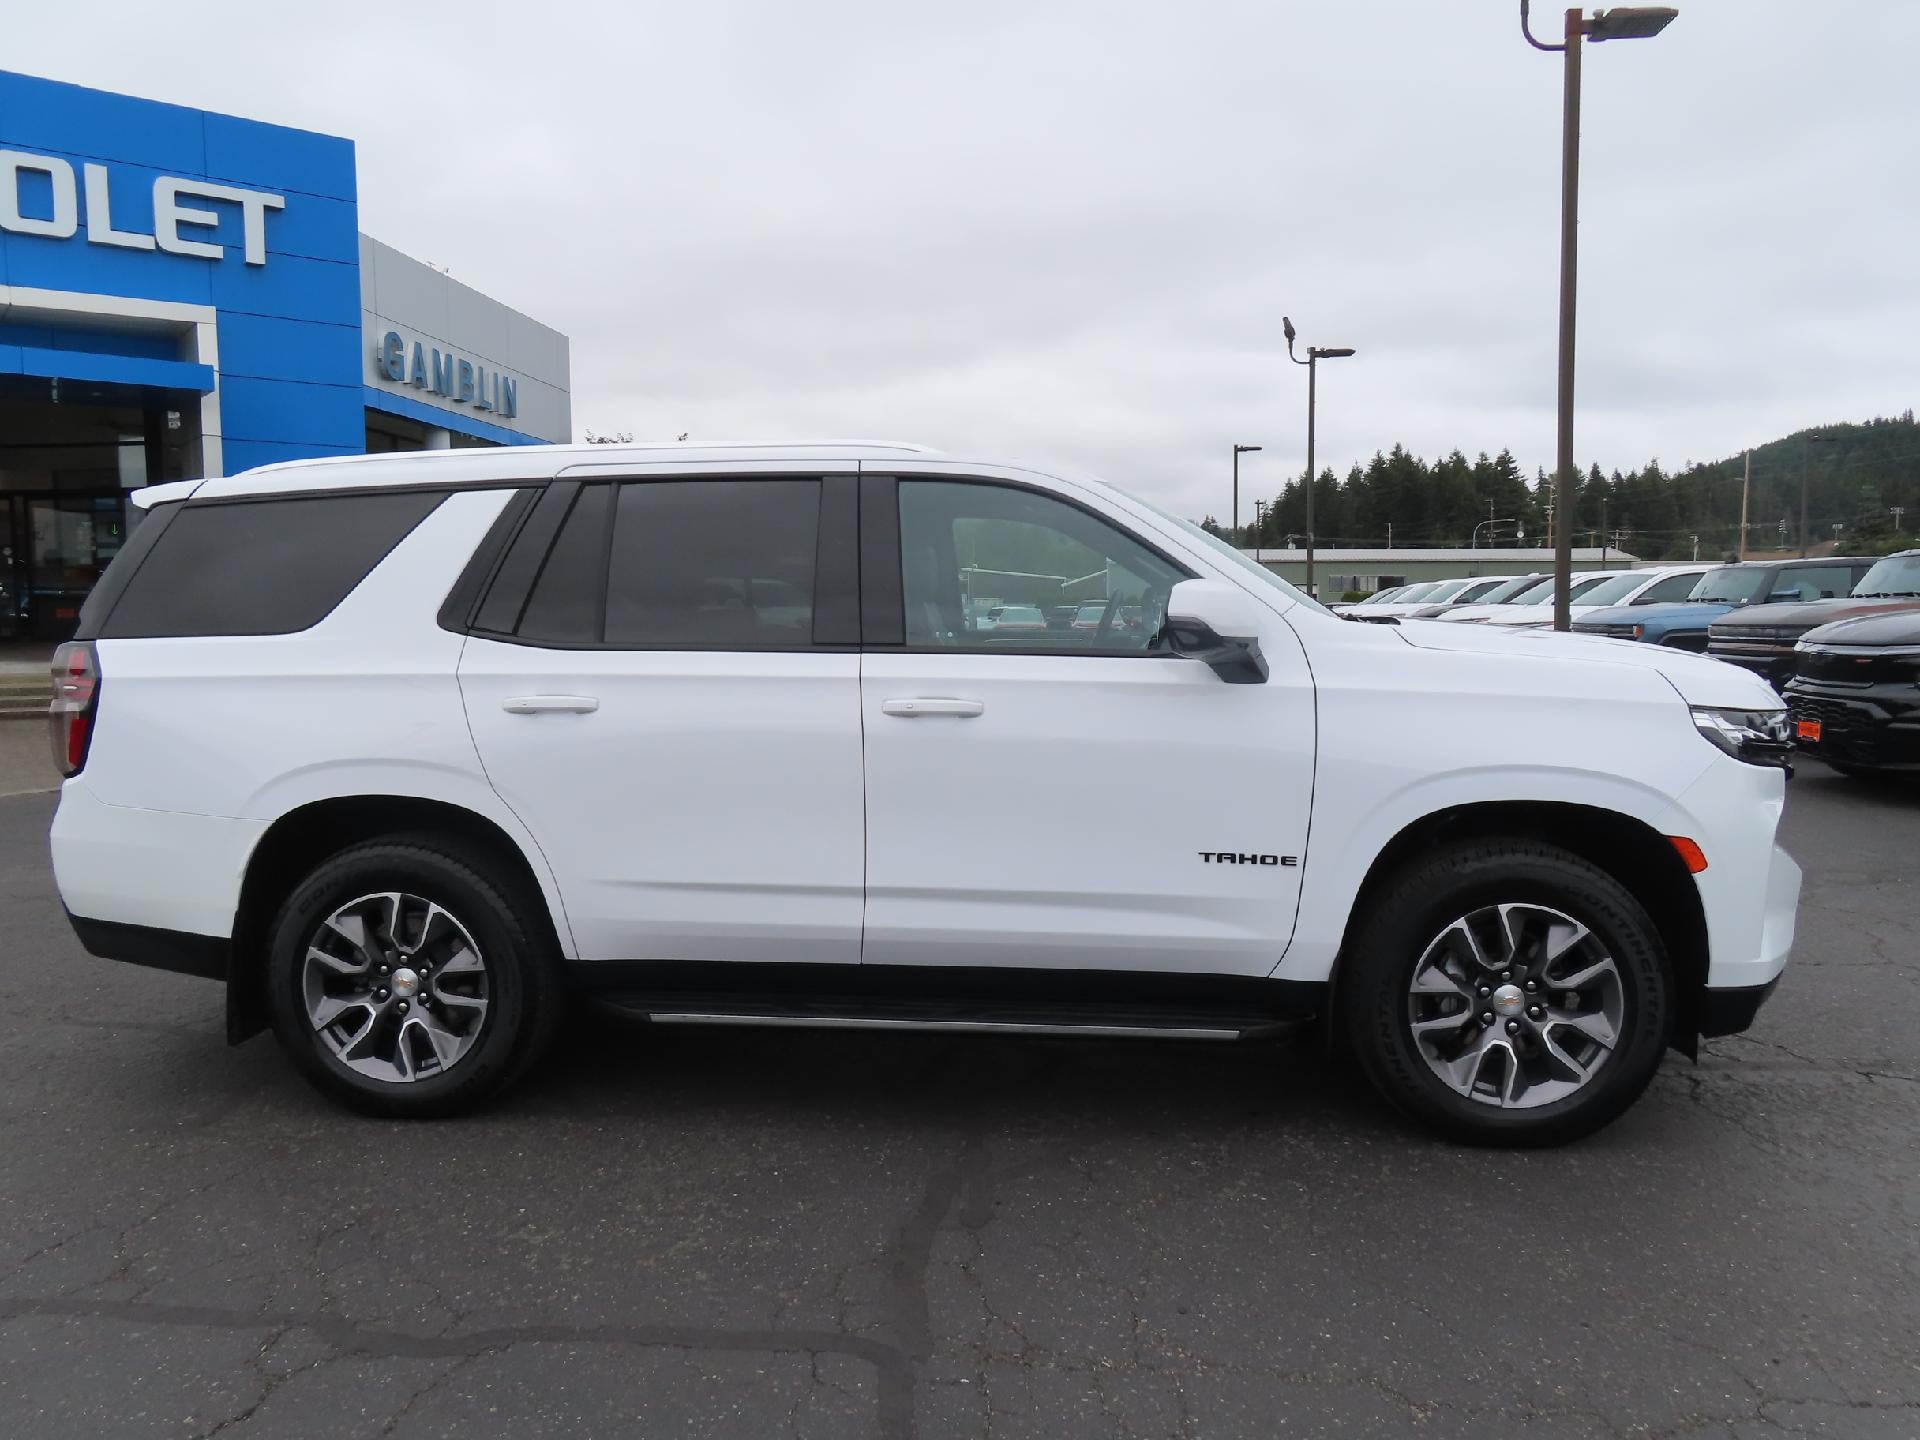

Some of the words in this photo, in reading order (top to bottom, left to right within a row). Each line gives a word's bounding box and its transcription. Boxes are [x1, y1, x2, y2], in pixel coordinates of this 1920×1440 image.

[0, 150, 286, 265] OLET
[383, 331, 517, 418] GAMBLIN
[1198, 852, 1297, 866] TAHOE
